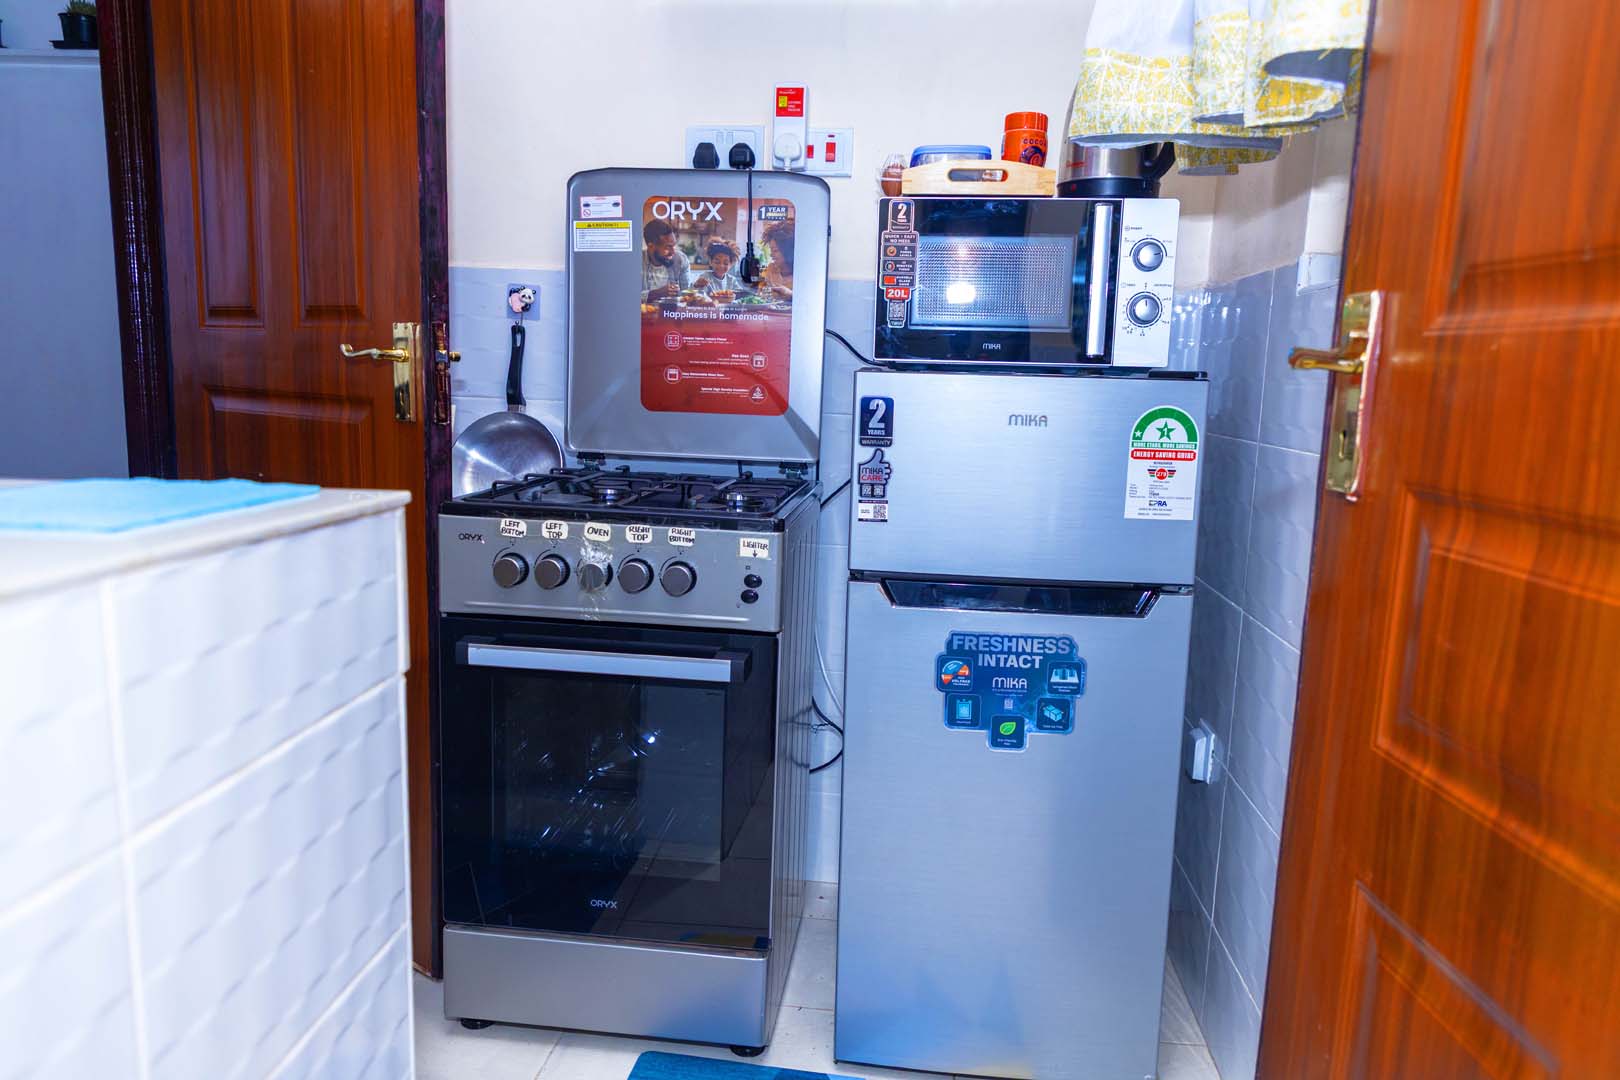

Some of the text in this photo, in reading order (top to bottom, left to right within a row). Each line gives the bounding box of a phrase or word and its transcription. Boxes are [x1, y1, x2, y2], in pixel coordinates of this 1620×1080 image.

[652, 201, 723, 221] ORYX
[760, 206, 766, 219] 1
[897, 203, 907, 219] 2
[887, 289, 909, 298] 20L
[663, 310, 769, 321] Happiness is homemade
[868, 398, 887, 429] 2
[1008, 414, 1048, 427] MIKA
[1162, 427, 1169, 438] 1
[1133, 450, 1154, 458] ENERGY
[1155, 451, 1176, 459] SAVING
[862, 467, 884, 475] MIKA
[546, 522, 564, 530] LEFT
[629, 525, 651, 533] RIGHT
[546, 531, 563, 539] TOP
[587, 526, 609, 537] OVEN
[671, 528, 692, 536] RIGHT
[458, 533, 483, 542] ORYX
[632, 533, 649, 541] TOP
[669, 535, 695, 544] BOTTOM
[742, 540, 768, 550] LIGHTER
[952, 635, 1071, 654] FRESHNESS
[978, 653, 1043, 669] INTACT
[992, 676, 1028, 689] MIKA
[590, 899, 617, 909] ORYX
